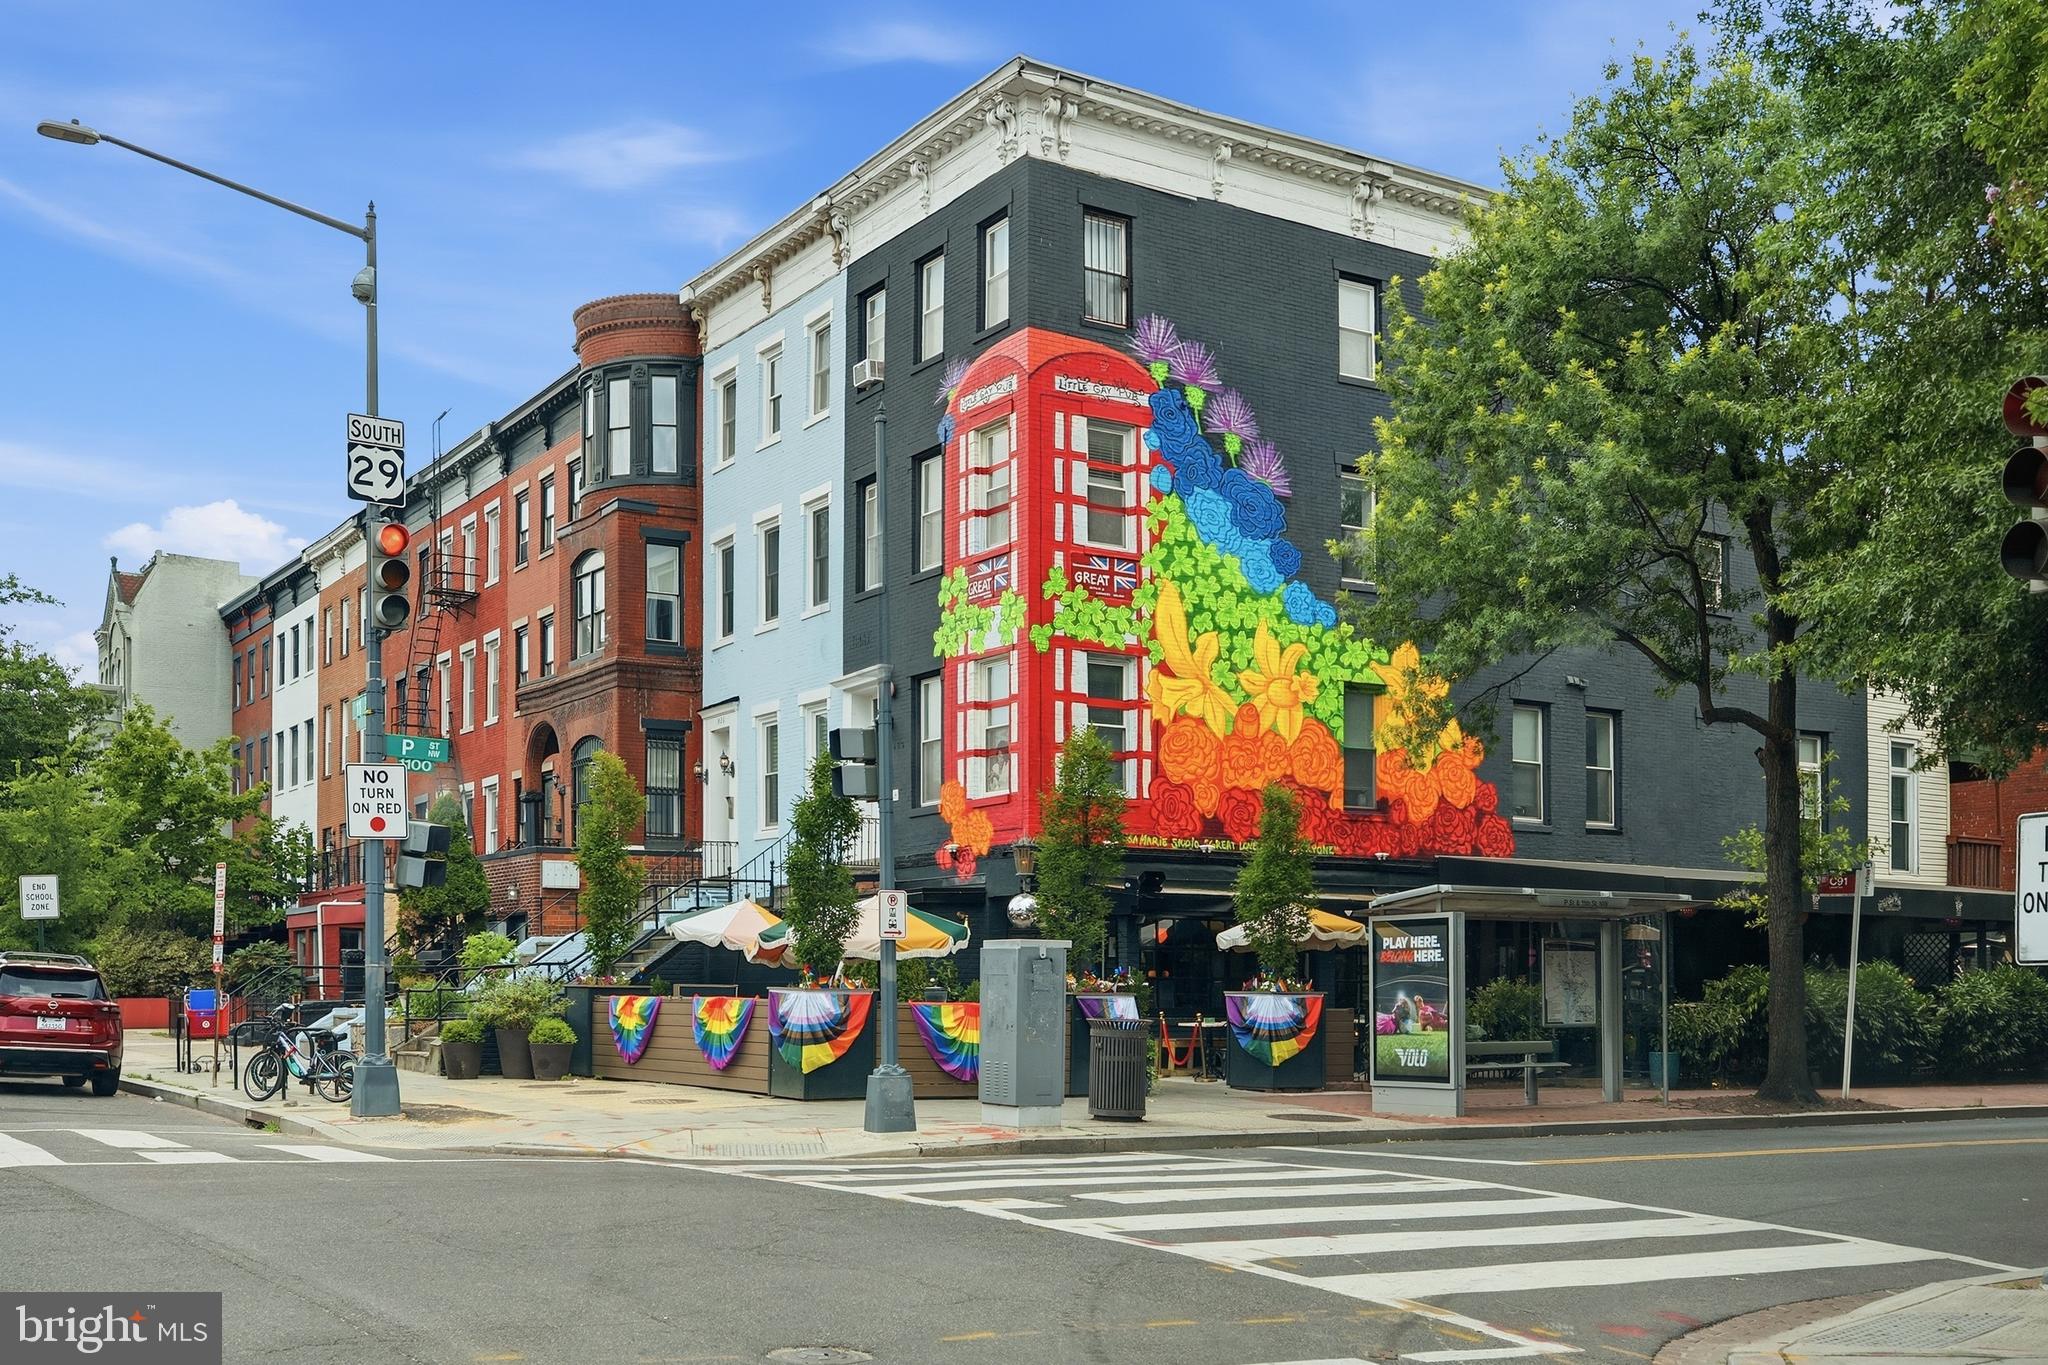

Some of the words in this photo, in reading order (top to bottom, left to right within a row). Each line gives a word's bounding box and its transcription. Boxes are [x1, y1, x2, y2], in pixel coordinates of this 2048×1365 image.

[1093, 386, 1112, 395] GAY
[1118, 387, 1139, 400] PUB
[351, 419, 401, 444] SOUTH
[353, 455, 398, 489] 29
[1074, 571, 1110, 587] GREAT
[968, 577, 993, 596] GREAT
[402, 738, 415, 756] P
[429, 742, 440, 750] ST
[428, 749, 440, 758] NW
[363, 770, 389, 784] NO
[360, 787, 394, 799] TURN
[352, 802, 370, 814] ON
[377, 803, 402, 814] RED
[32, 883, 47, 891] END
[1829, 876, 1848, 887] C91
[25, 893, 54, 901] SCHOOL
[31, 903, 50, 911] ZONE
[1383, 936, 1408, 950] PLAY
[1410, 935, 1440, 949] HERE.
[1379, 949, 1413, 963] BELONG
[1414, 948, 1444, 962] HERE.
[1395, 1048, 1428, 1067] VOLO
